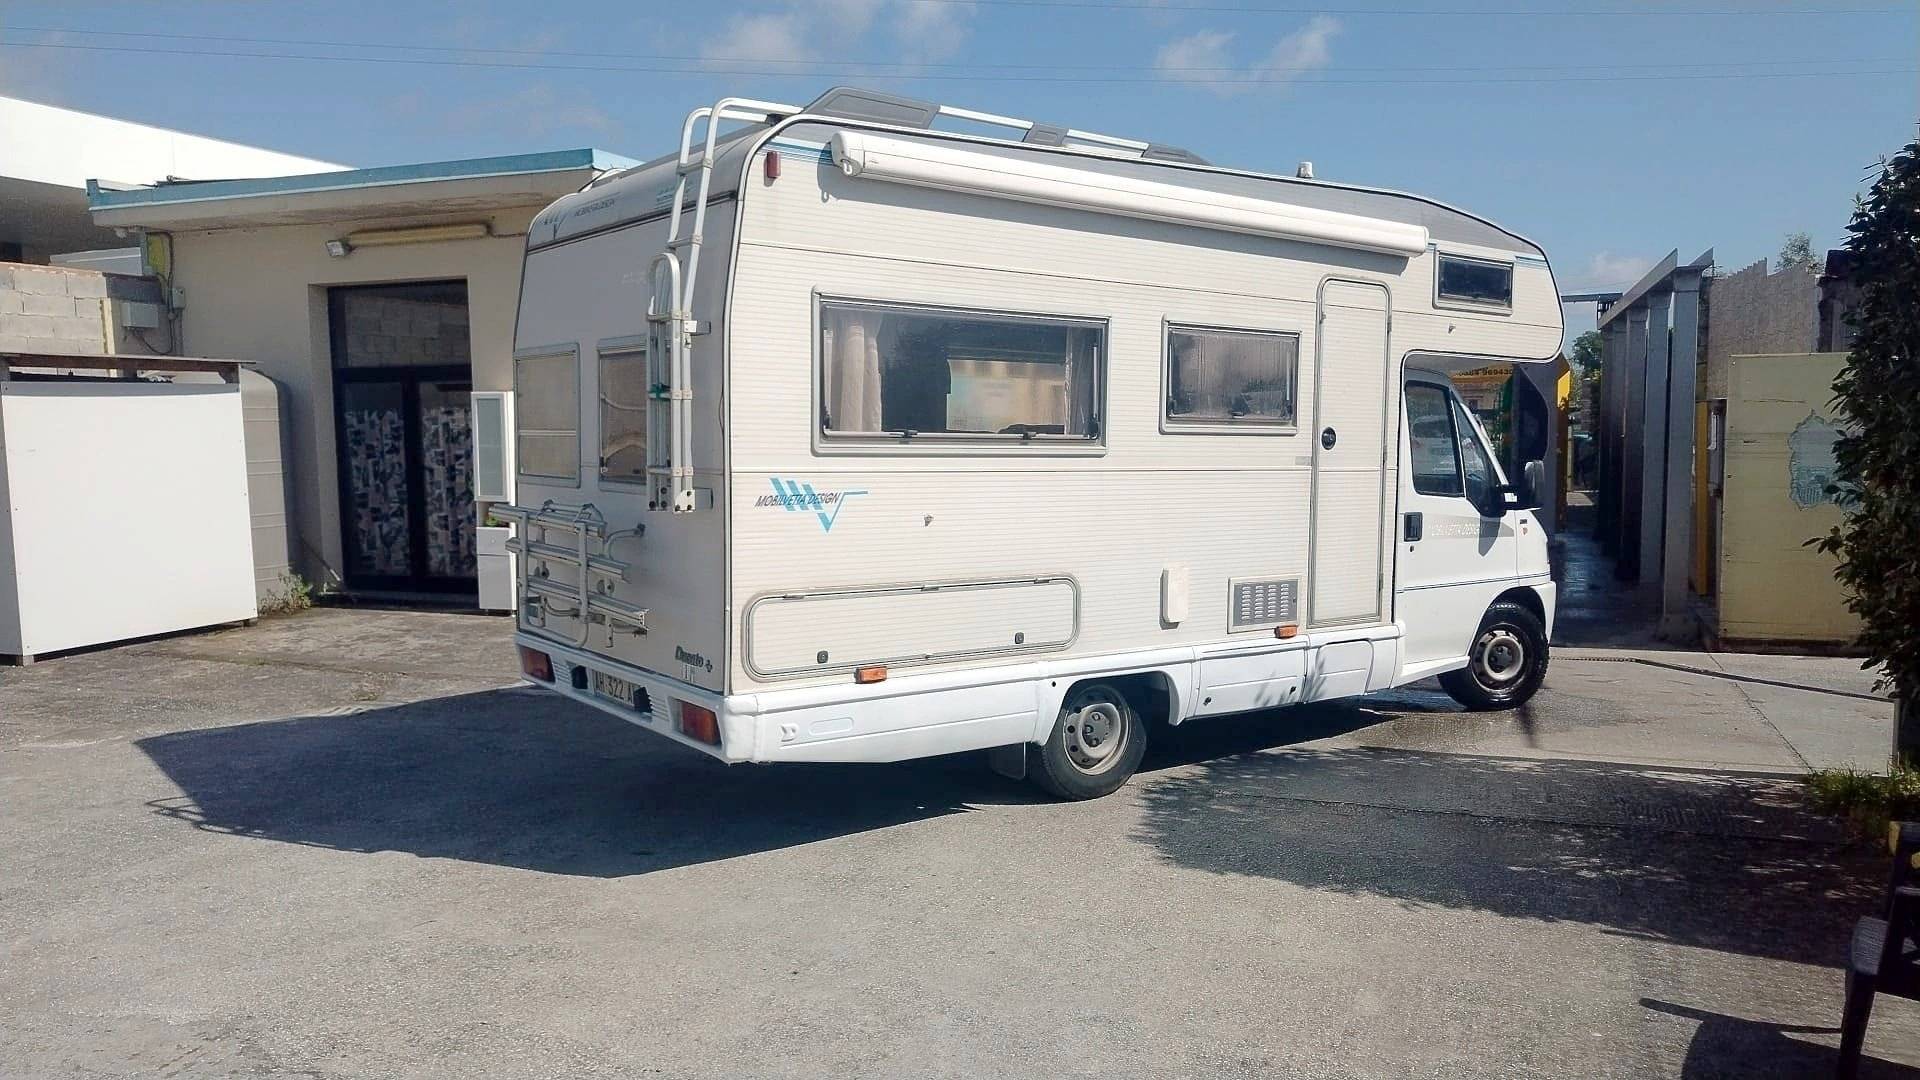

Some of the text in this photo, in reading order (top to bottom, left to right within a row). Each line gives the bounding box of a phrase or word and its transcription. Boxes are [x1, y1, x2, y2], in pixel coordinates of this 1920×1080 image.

[755, 492, 841, 507] MOBILVETTA DESIGN
[608, 676, 625, 700] 322
